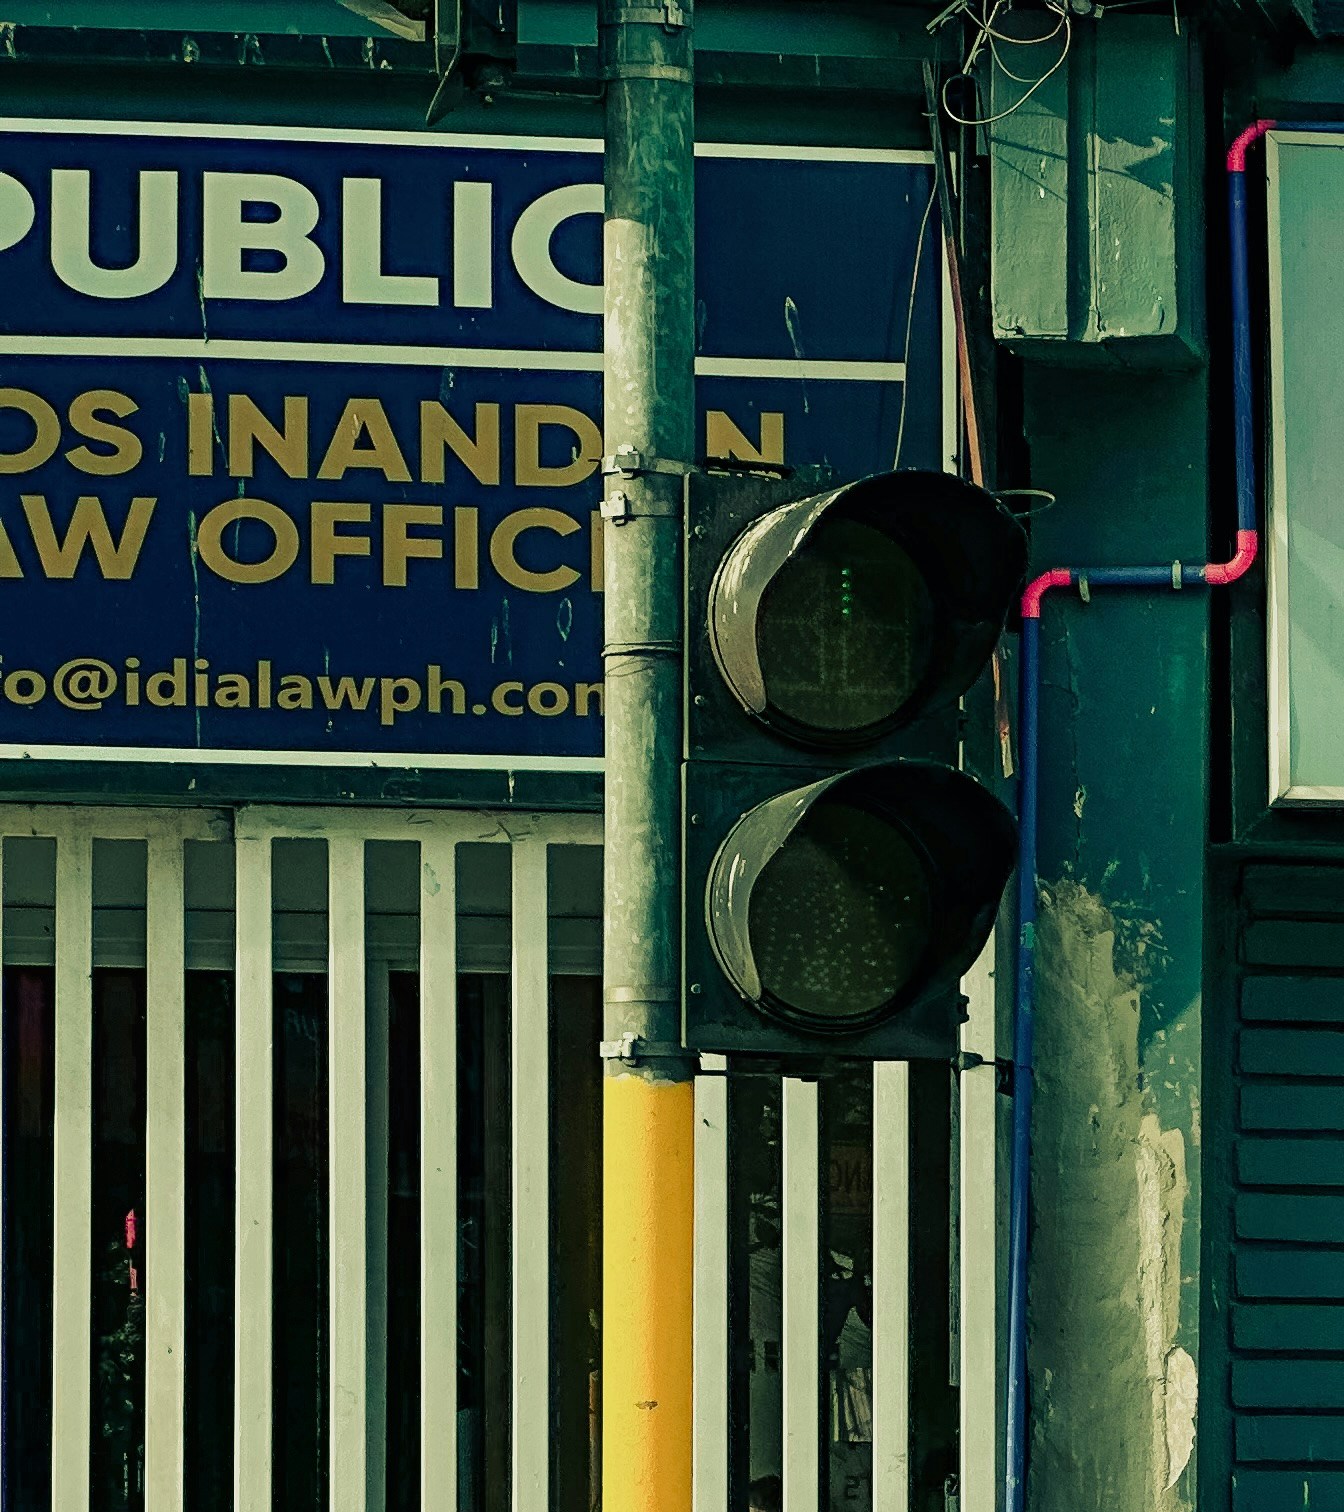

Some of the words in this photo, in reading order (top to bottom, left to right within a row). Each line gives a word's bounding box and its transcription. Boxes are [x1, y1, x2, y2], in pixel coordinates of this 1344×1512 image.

[188, 392, 785, 487] INANDN
[0, 494, 158, 581] W
[198, 498, 604, 593] OFFIC
[0, 655, 605, 726] o@idialawph.co
